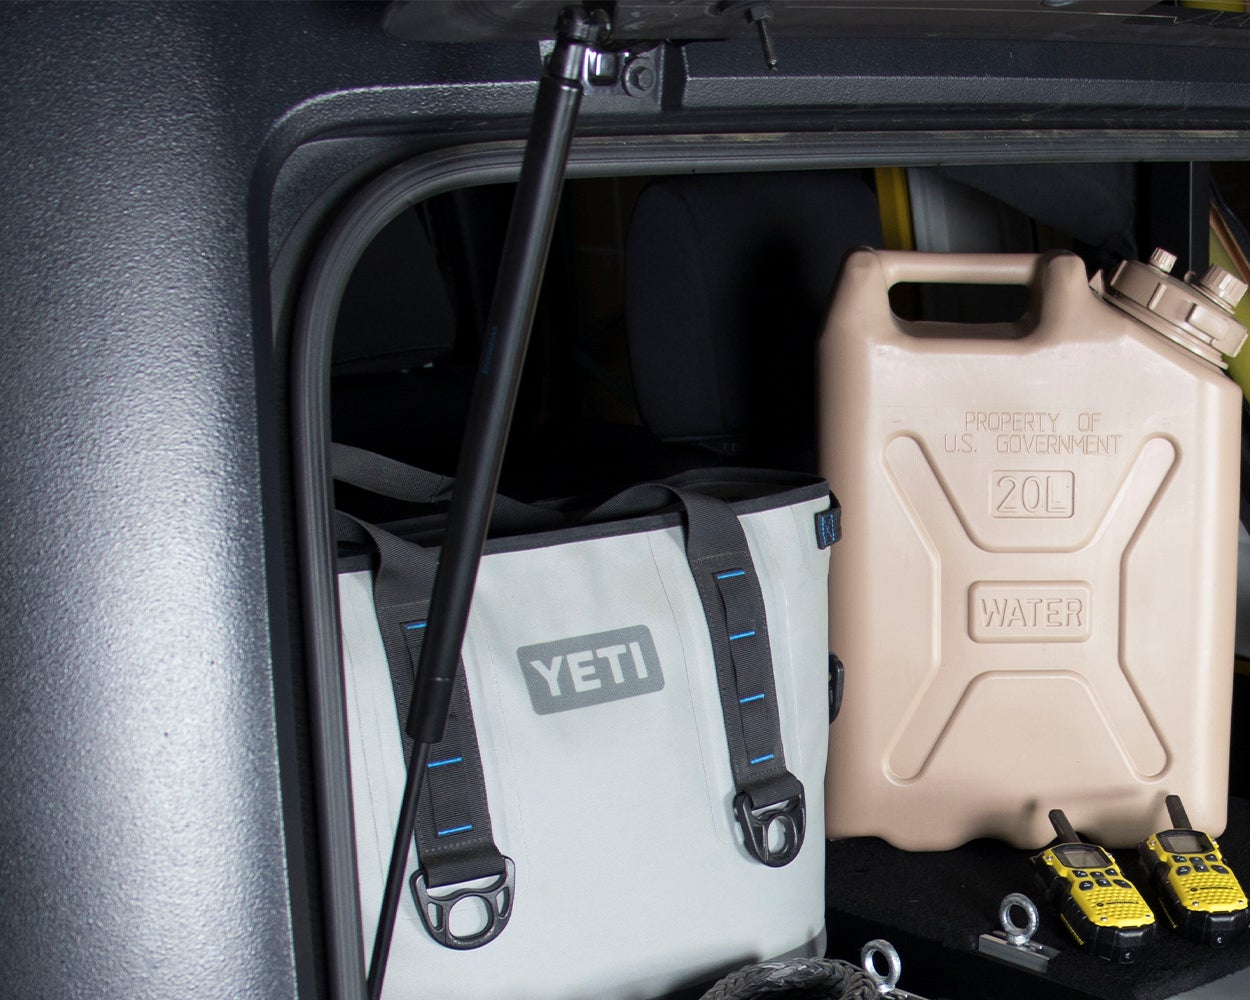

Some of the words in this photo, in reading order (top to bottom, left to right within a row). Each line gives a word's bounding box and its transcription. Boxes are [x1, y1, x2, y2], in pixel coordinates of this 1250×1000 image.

[964, 410, 1060, 433] PROPERTY
[1078, 411, 1103, 433] OF
[944, 432, 977, 454] U.S.
[996, 433, 1122, 455] GOVERNMENT
[997, 474, 1067, 513] 20L
[981, 598, 1083, 628] WATER
[530, 641, 649, 697] YETI
